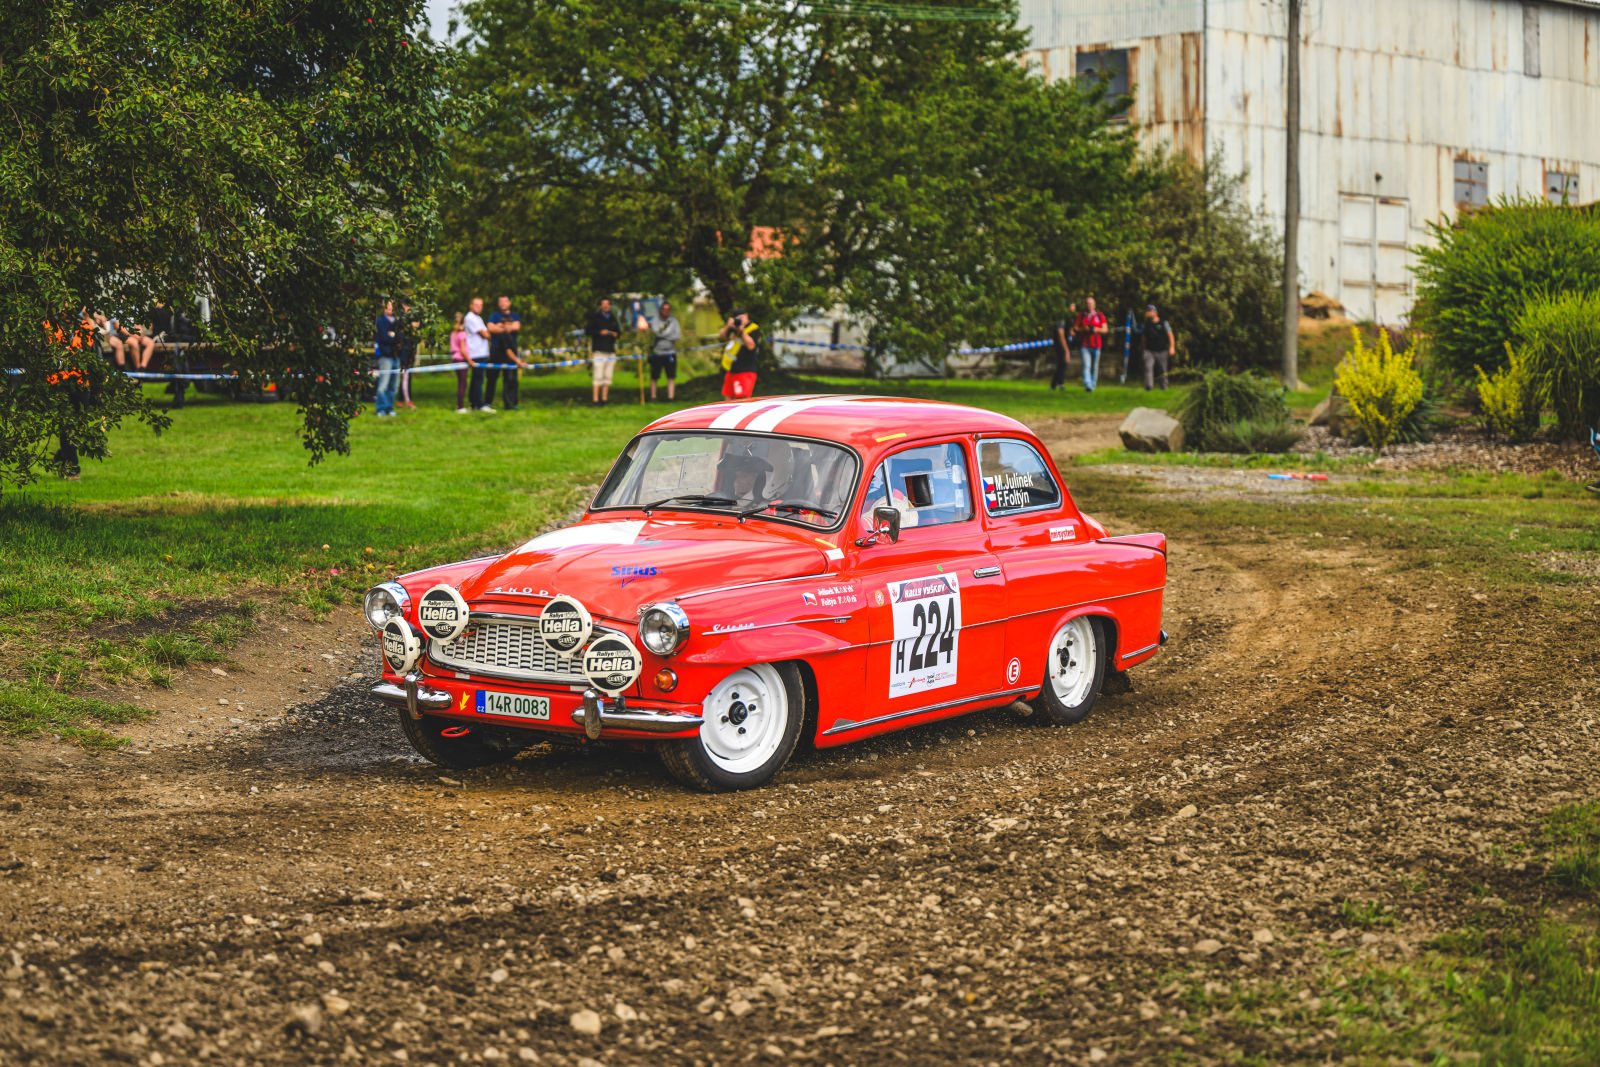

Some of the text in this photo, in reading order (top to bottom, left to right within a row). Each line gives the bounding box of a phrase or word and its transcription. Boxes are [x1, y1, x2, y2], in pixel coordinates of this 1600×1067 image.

[611, 564, 657, 576] Sirius
[422, 607, 457, 620] Hella
[543, 619, 580, 633] Hella
[895, 597, 955, 675] H 224
[384, 637, 404, 655] Hella
[589, 657, 633, 671] Hella
[1010, 664, 1018, 679] E
[477, 694, 548, 717] CZ 14R 0083
